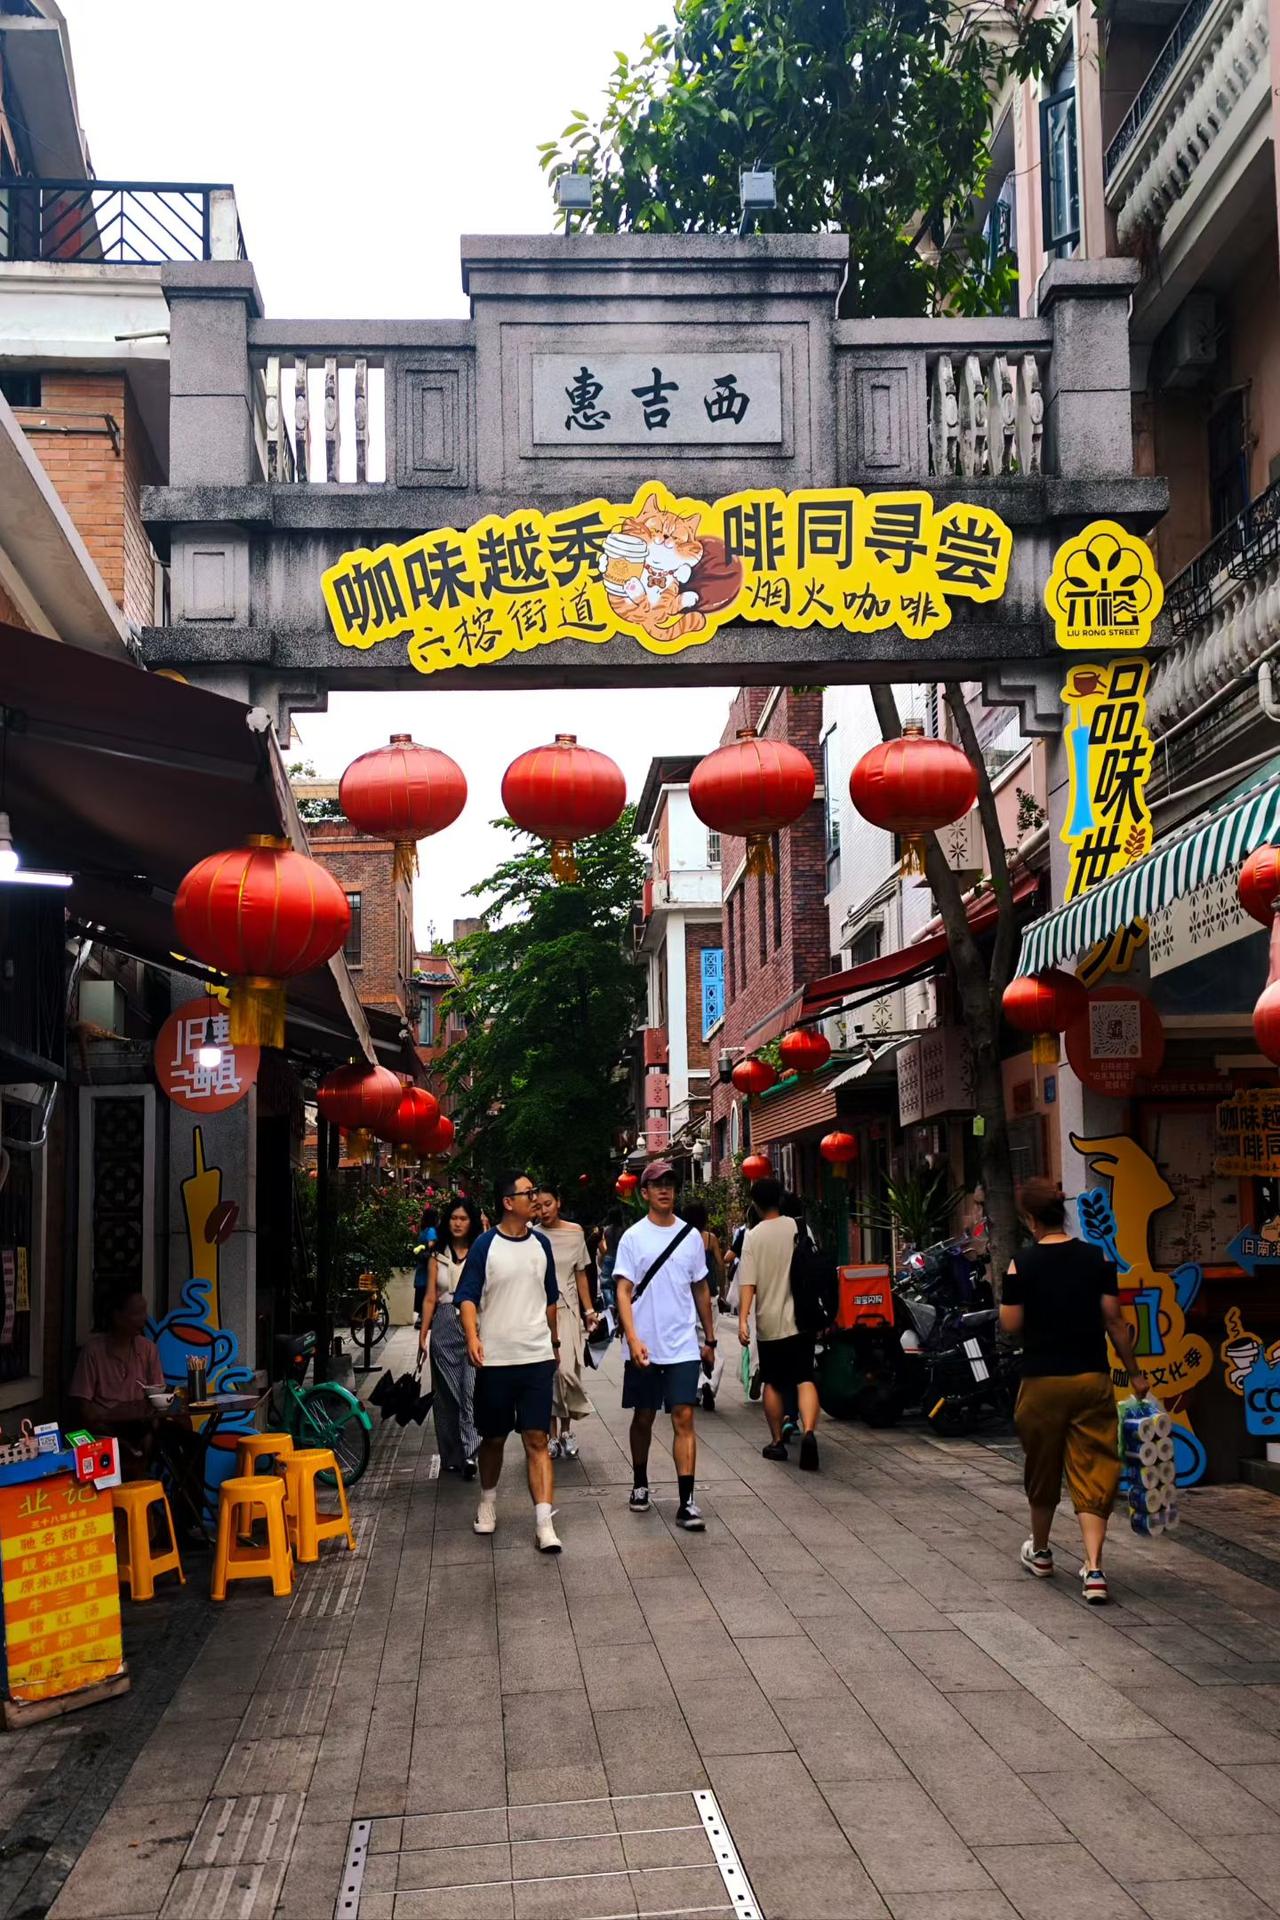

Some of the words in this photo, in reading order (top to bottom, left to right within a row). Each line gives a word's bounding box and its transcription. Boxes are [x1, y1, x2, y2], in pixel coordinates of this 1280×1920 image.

[565, 366, 751, 431] 惠吉西
[332, 512, 612, 636] 咖味越秀
[723, 500, 1001, 589] 啡同寻尝
[417, 582, 608, 663] 六榕街道
[745, 576, 941, 626] 烟火咖啡
[1066, 629, 1080, 637] LIU
[1082, 629, 1107, 637] RONG
[1108, 628, 1140, 636] STREET
